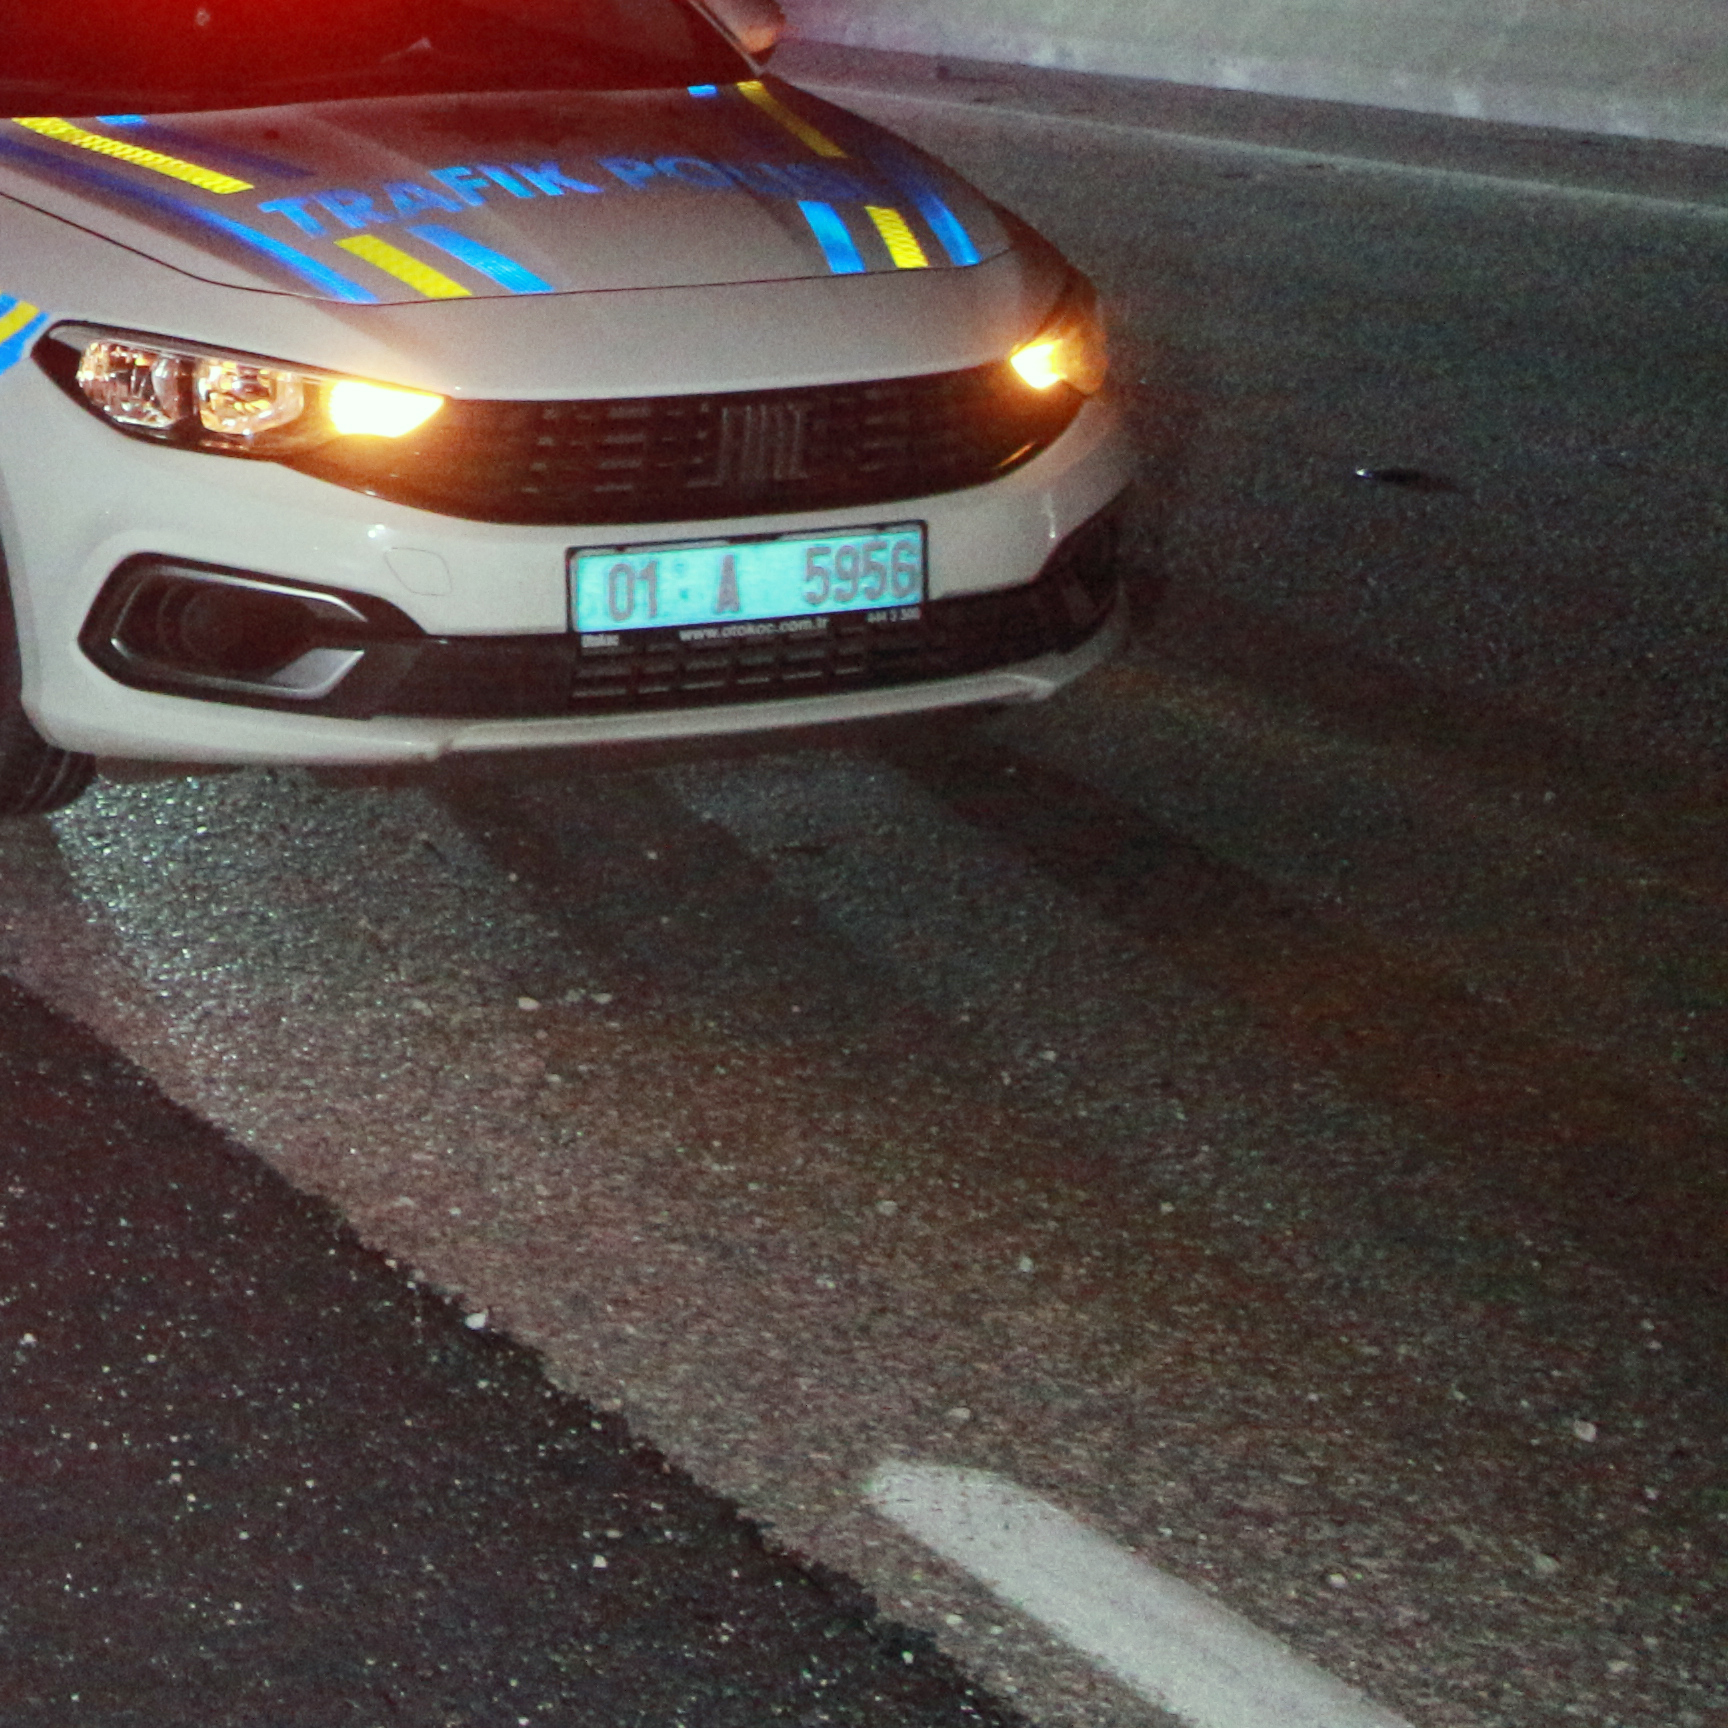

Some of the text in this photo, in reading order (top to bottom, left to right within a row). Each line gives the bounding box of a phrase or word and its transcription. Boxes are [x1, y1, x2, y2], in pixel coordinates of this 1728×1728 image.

[608, 539, 920, 622] 01 A 5956
